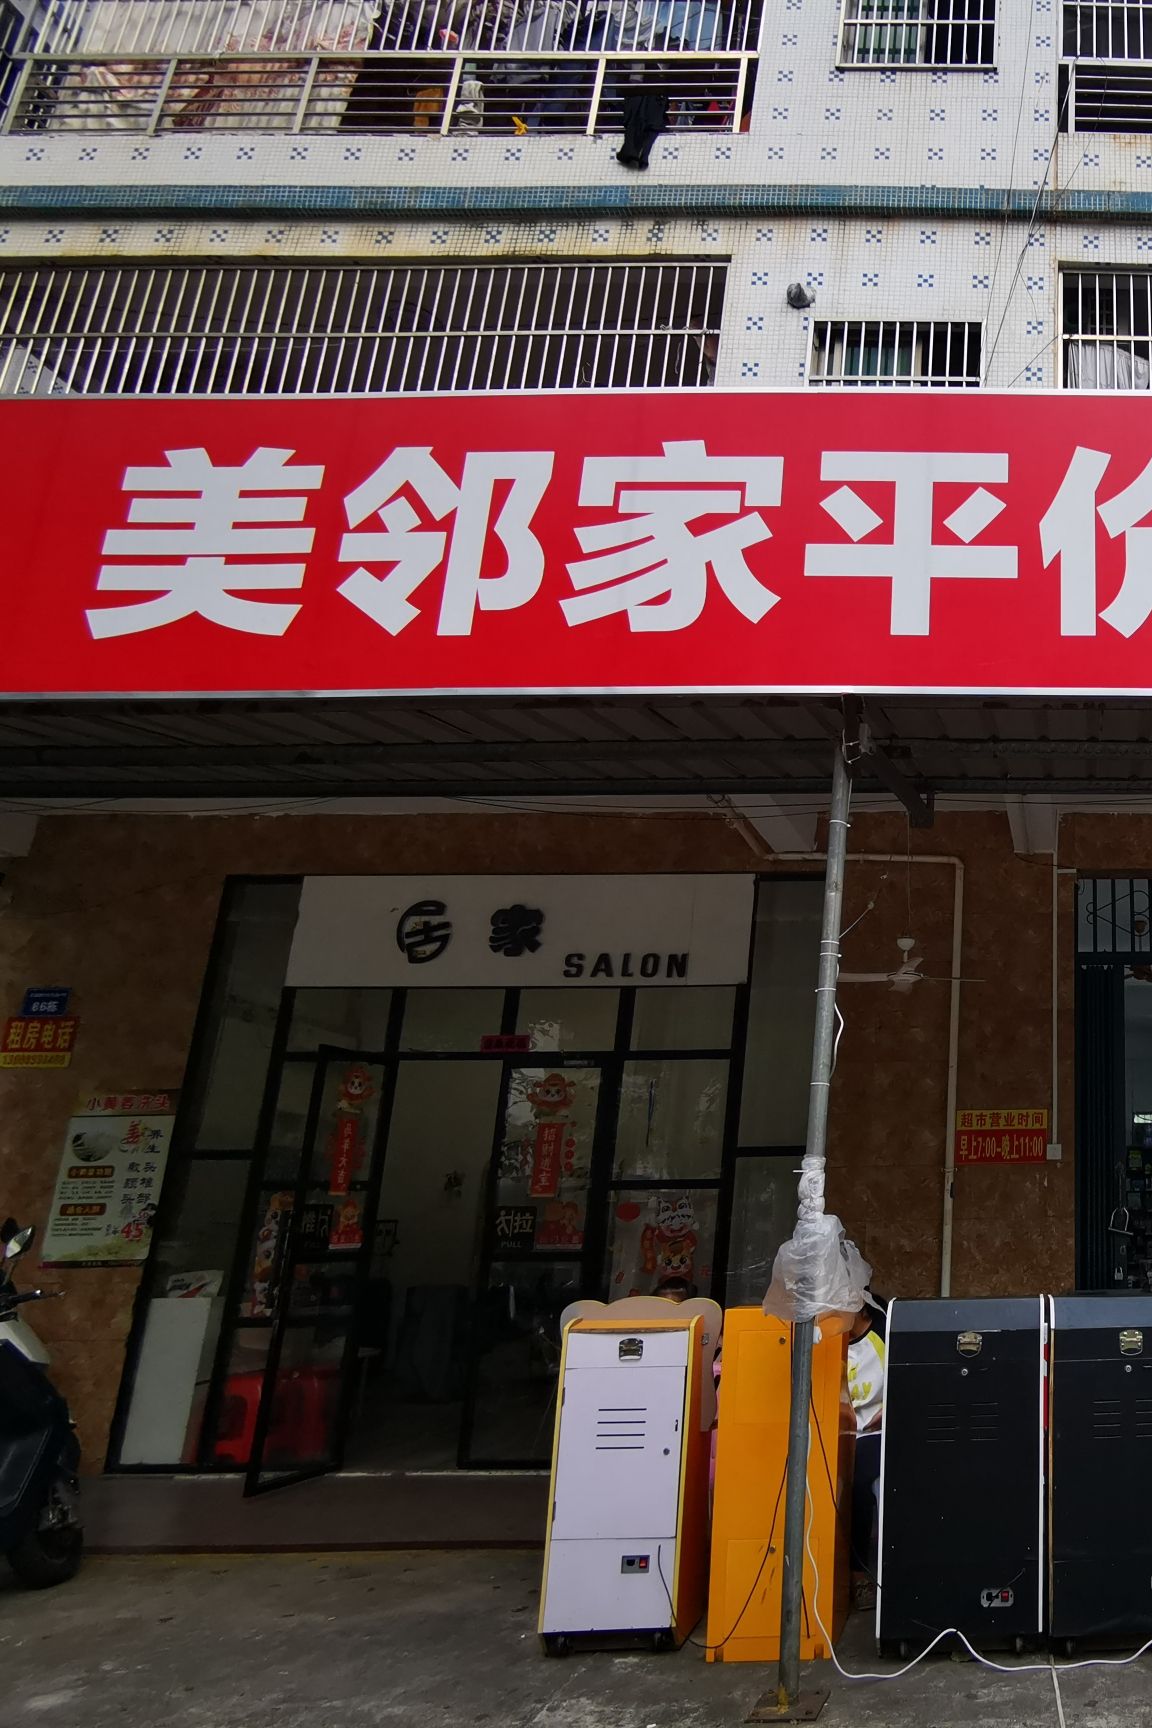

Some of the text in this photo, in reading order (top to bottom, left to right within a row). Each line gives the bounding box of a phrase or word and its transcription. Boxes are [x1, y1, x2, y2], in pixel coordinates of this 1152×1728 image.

[563, 952, 690, 979] SALON
[6, 1021, 75, 1050] 租房电话
[961, 1112, 1044, 1128] 超市营业时间
